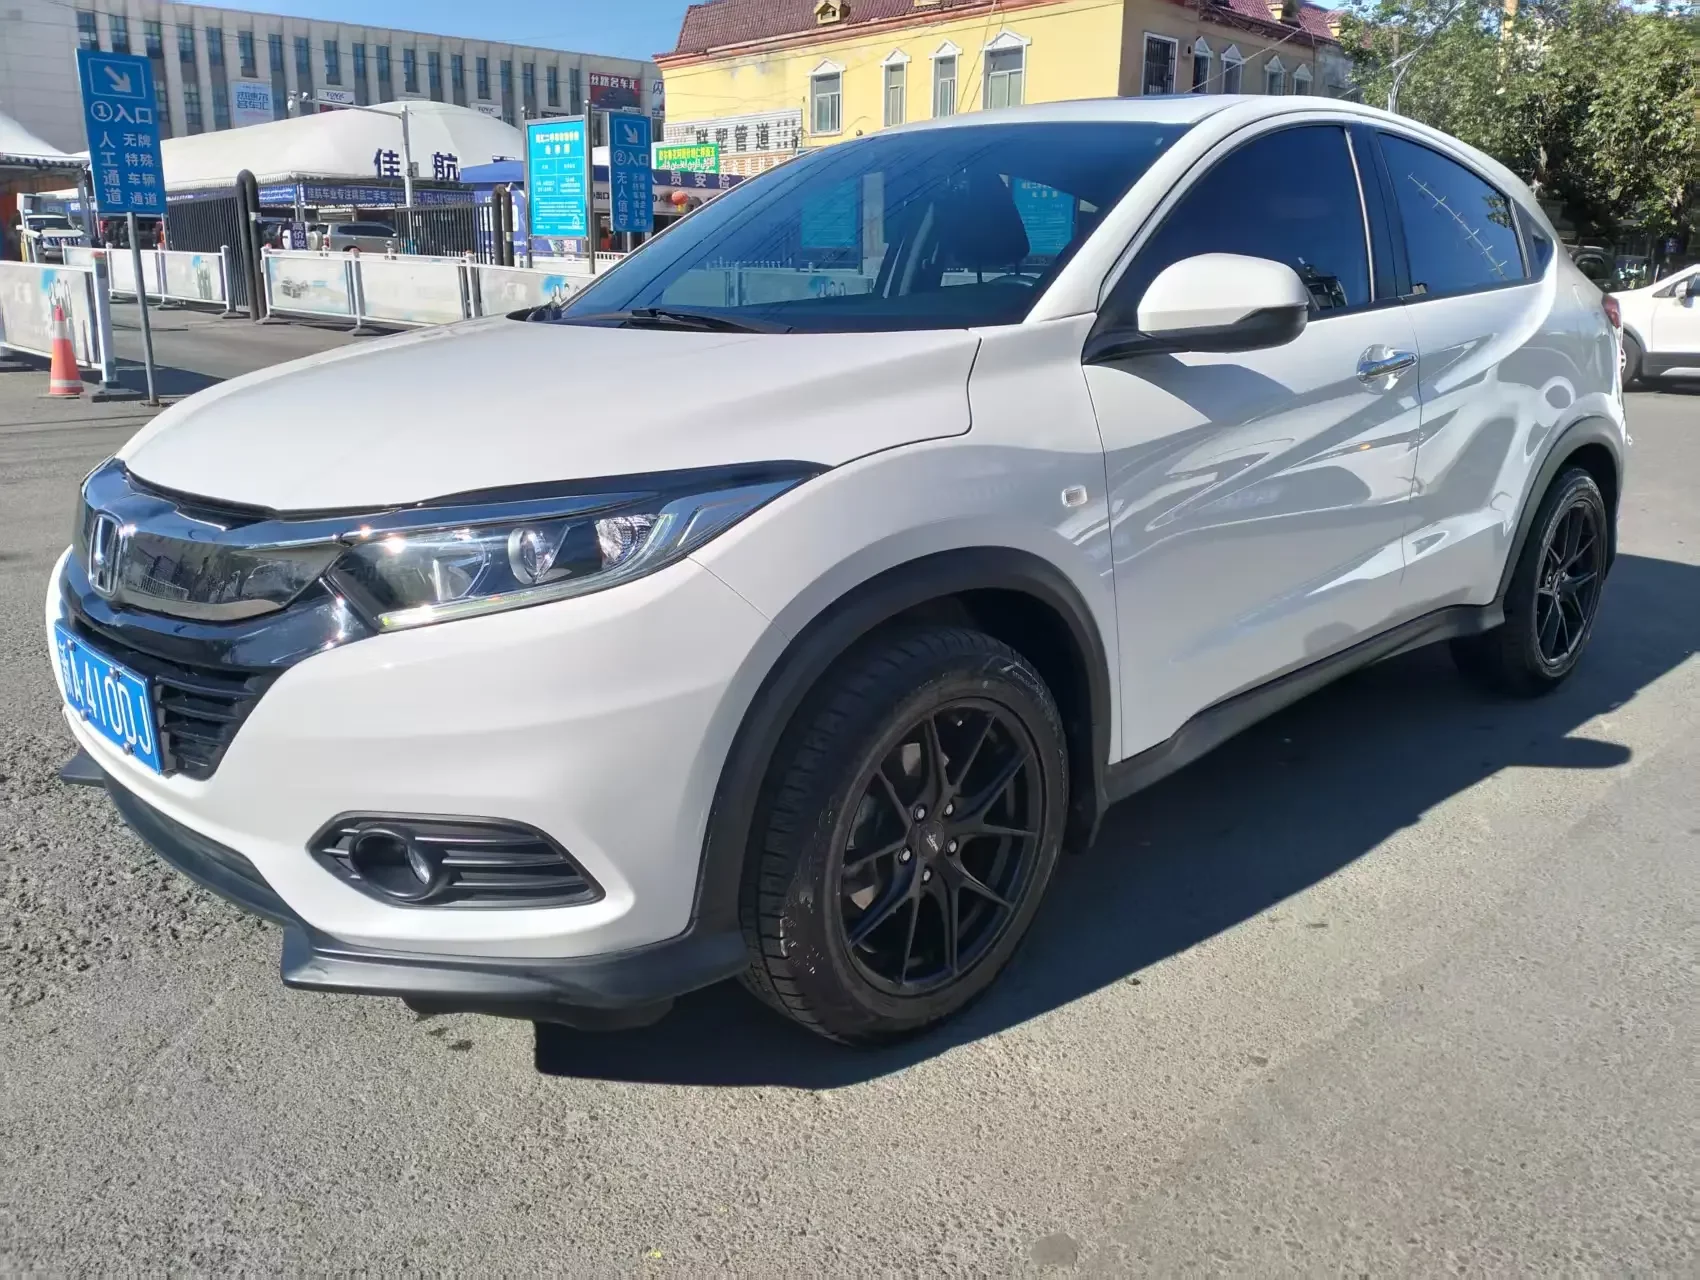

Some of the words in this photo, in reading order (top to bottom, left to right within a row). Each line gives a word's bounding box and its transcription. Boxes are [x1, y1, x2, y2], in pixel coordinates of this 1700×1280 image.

[123, 133, 151, 148] 无牌
[99, 131, 123, 205] 人工通道
[125, 153, 154, 168] 特殊
[128, 172, 156, 187] 车辆
[130, 192, 158, 206] 通道
